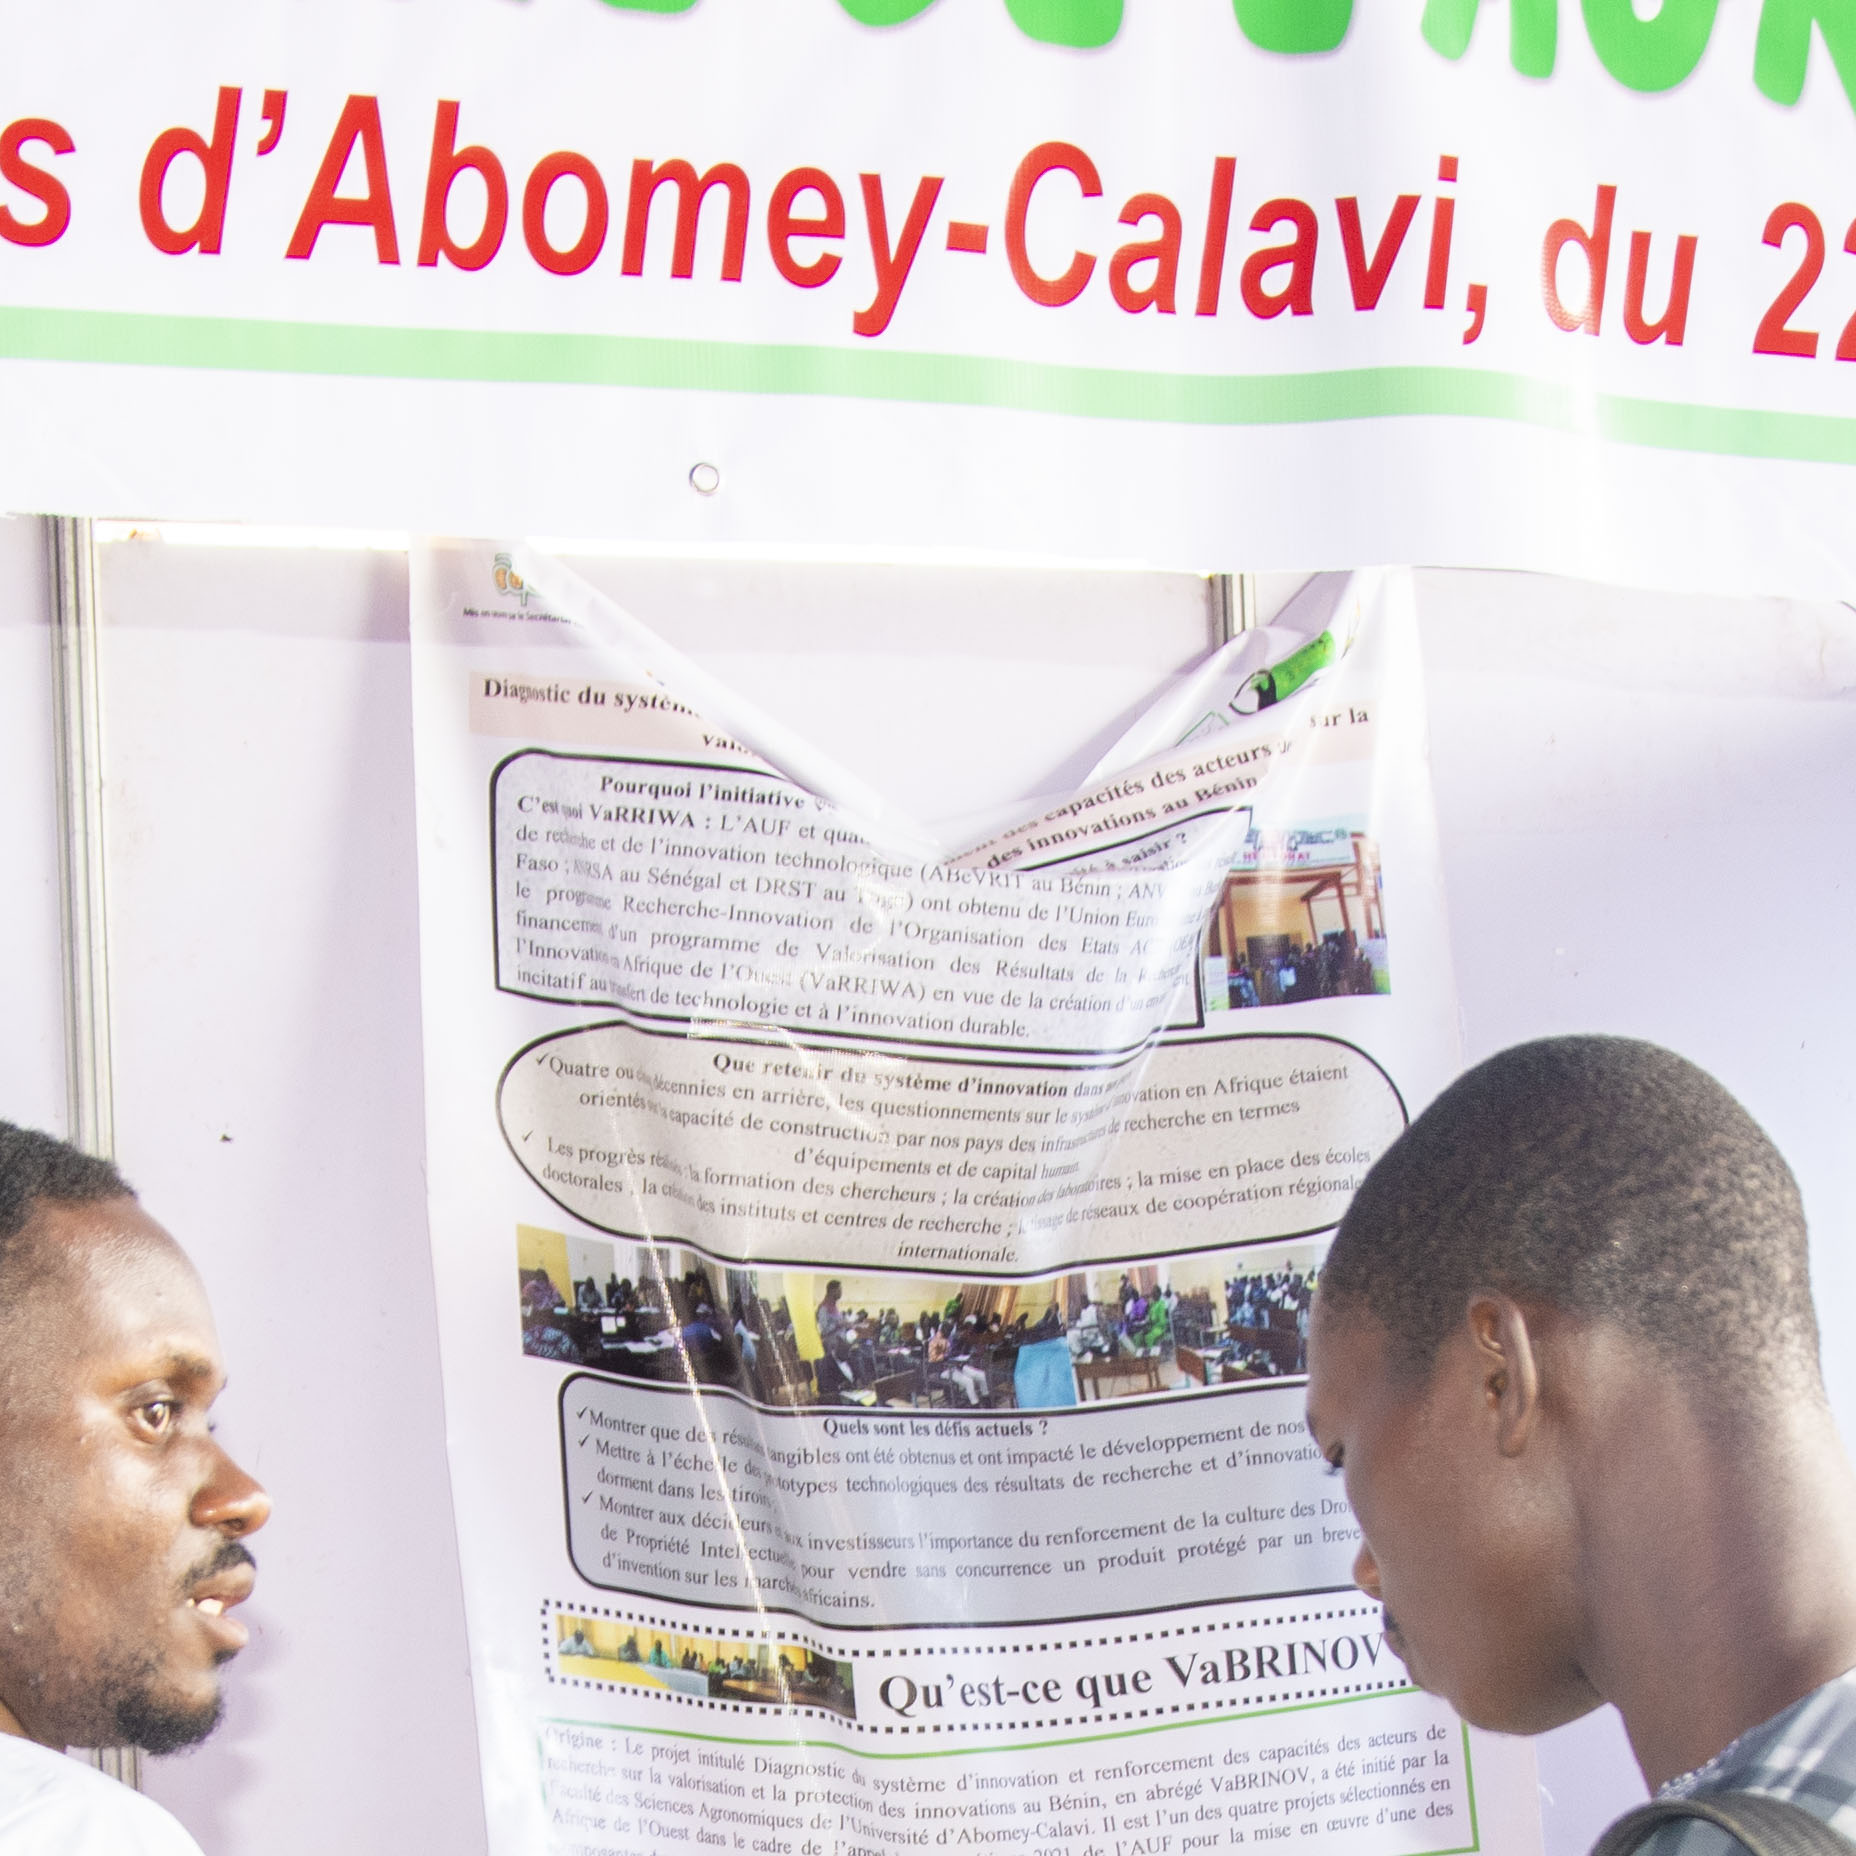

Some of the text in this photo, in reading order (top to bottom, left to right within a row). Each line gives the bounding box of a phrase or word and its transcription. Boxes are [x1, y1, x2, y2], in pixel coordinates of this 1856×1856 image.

[1542, 184, 1700, 345] du
[484, 678, 605, 705] Diagnostic du
[600, 776, 691, 799] Pourquoi
[1151, 767, 1186, 789] des
[1193, 743, 1272, 778] acteurs
[589, 805, 694, 828] VaRRIWA
[1028, 810, 1156, 852] innovations
[516, 853, 559, 871] Faso
[647, 869, 720, 891] Sénégal
[958, 900, 1019, 918] obtenu
[651, 930, 1073, 981] programme Résultats
[960, 1016, 1029, 1038] durable.
[871, 1064, 1348, 1123] questionnements Afrique étaient
[966, 1101, 1300, 1155] pays recherche termes
[841, 1146, 1371, 1203] chercheurs place écoles
[983, 1164, 1036, 1183] capital
[824, 1185, 1283, 1236] centres recherche coopération
[897, 1242, 1019, 1263] internationale.
[589, 1412, 1245, 1467] Montrer que impacté développement
[823, 1418, 869, 1436] Quels
[874, 1420, 904, 1436] sont
[910, 1420, 930, 1436] les
[934, 1420, 970, 1438] défis
[976, 1421, 1033, 1437] actuels
[846, 1459, 1192, 1496] technologiques résultats recherche
[599, 1495, 1285, 1552] Montrer investisseurs renforcement culture
[626, 1527, 1247, 1579] Propriété concurrence produit protégé
[1076, 1665, 1152, 1709] que
[651, 1746, 690, 1763] projet
[754, 1756, 845, 1779] Diagnostic
[873, 1775, 945, 1796] système
[1259, 1738, 1329, 1763] capacités
[1368, 1729, 1417, 1748] acteurs
[668, 1773, 745, 1797] valorisation
[915, 1797, 1016, 1819] innovations
[1049, 1792, 1107, 1811] Bénin,
[699, 1802, 803, 1831] Agronomiques
[1228, 1799, 1278, 1820] quatre
[1284, 1790, 1335, 1815] projets
